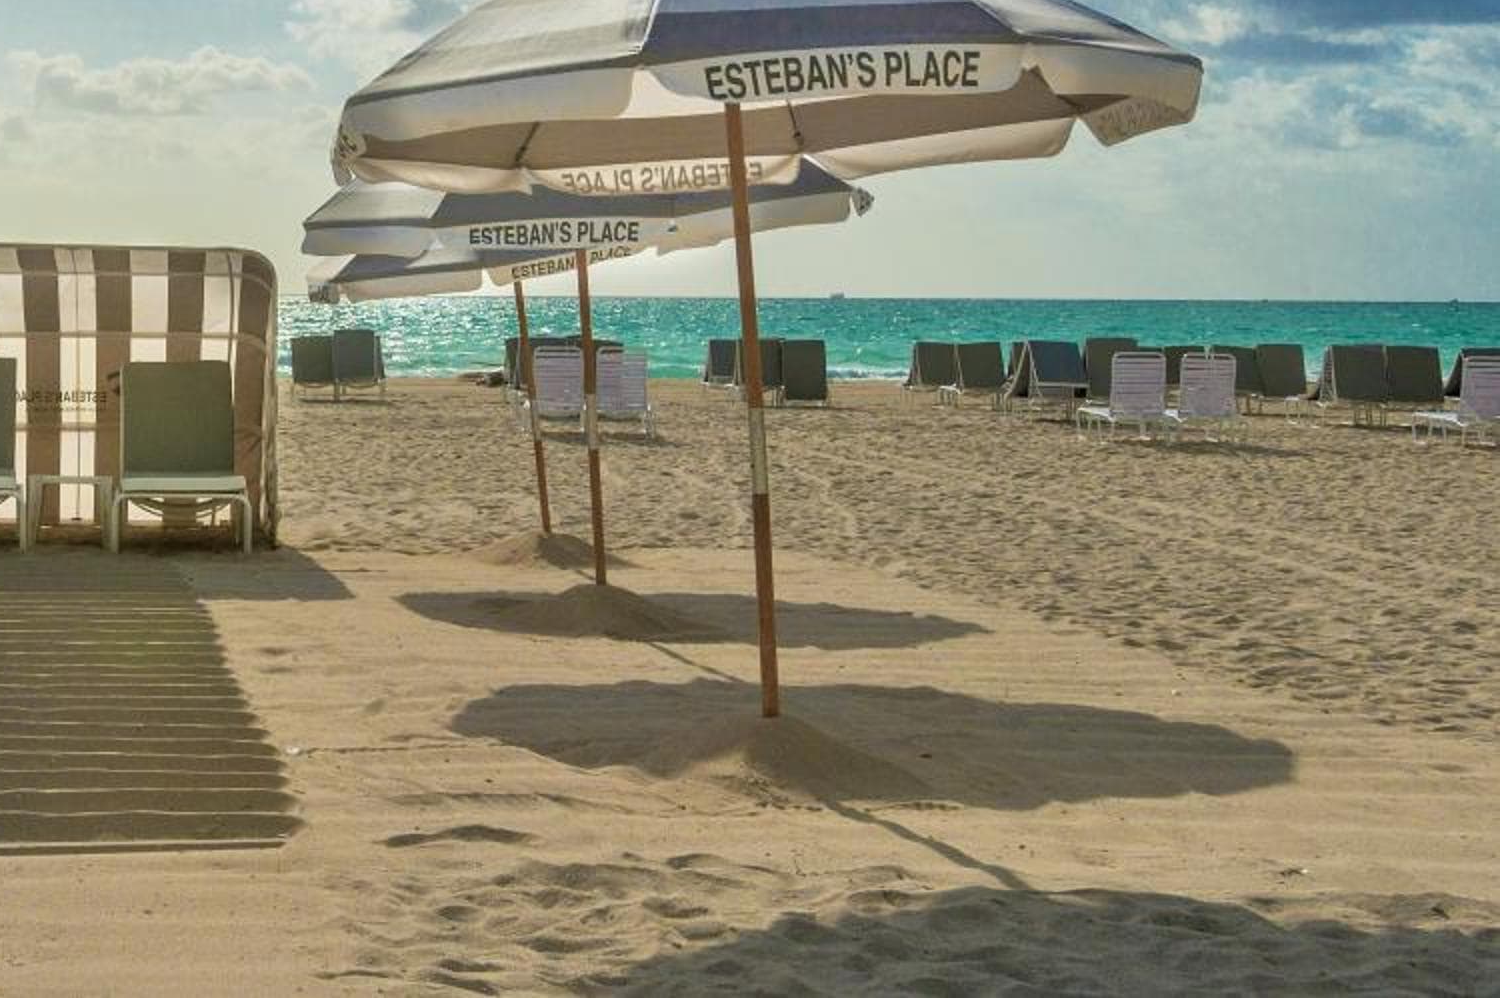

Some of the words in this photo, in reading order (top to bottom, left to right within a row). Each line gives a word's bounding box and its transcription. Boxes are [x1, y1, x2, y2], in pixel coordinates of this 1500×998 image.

[704, 51, 877, 101] ESTEBAN'S
[883, 50, 981, 88] PLACE
[469, 221, 573, 245] ESTEBAN'S
[577, 221, 640, 244] PLACE
[510, 256, 576, 280] ESTEBAN
